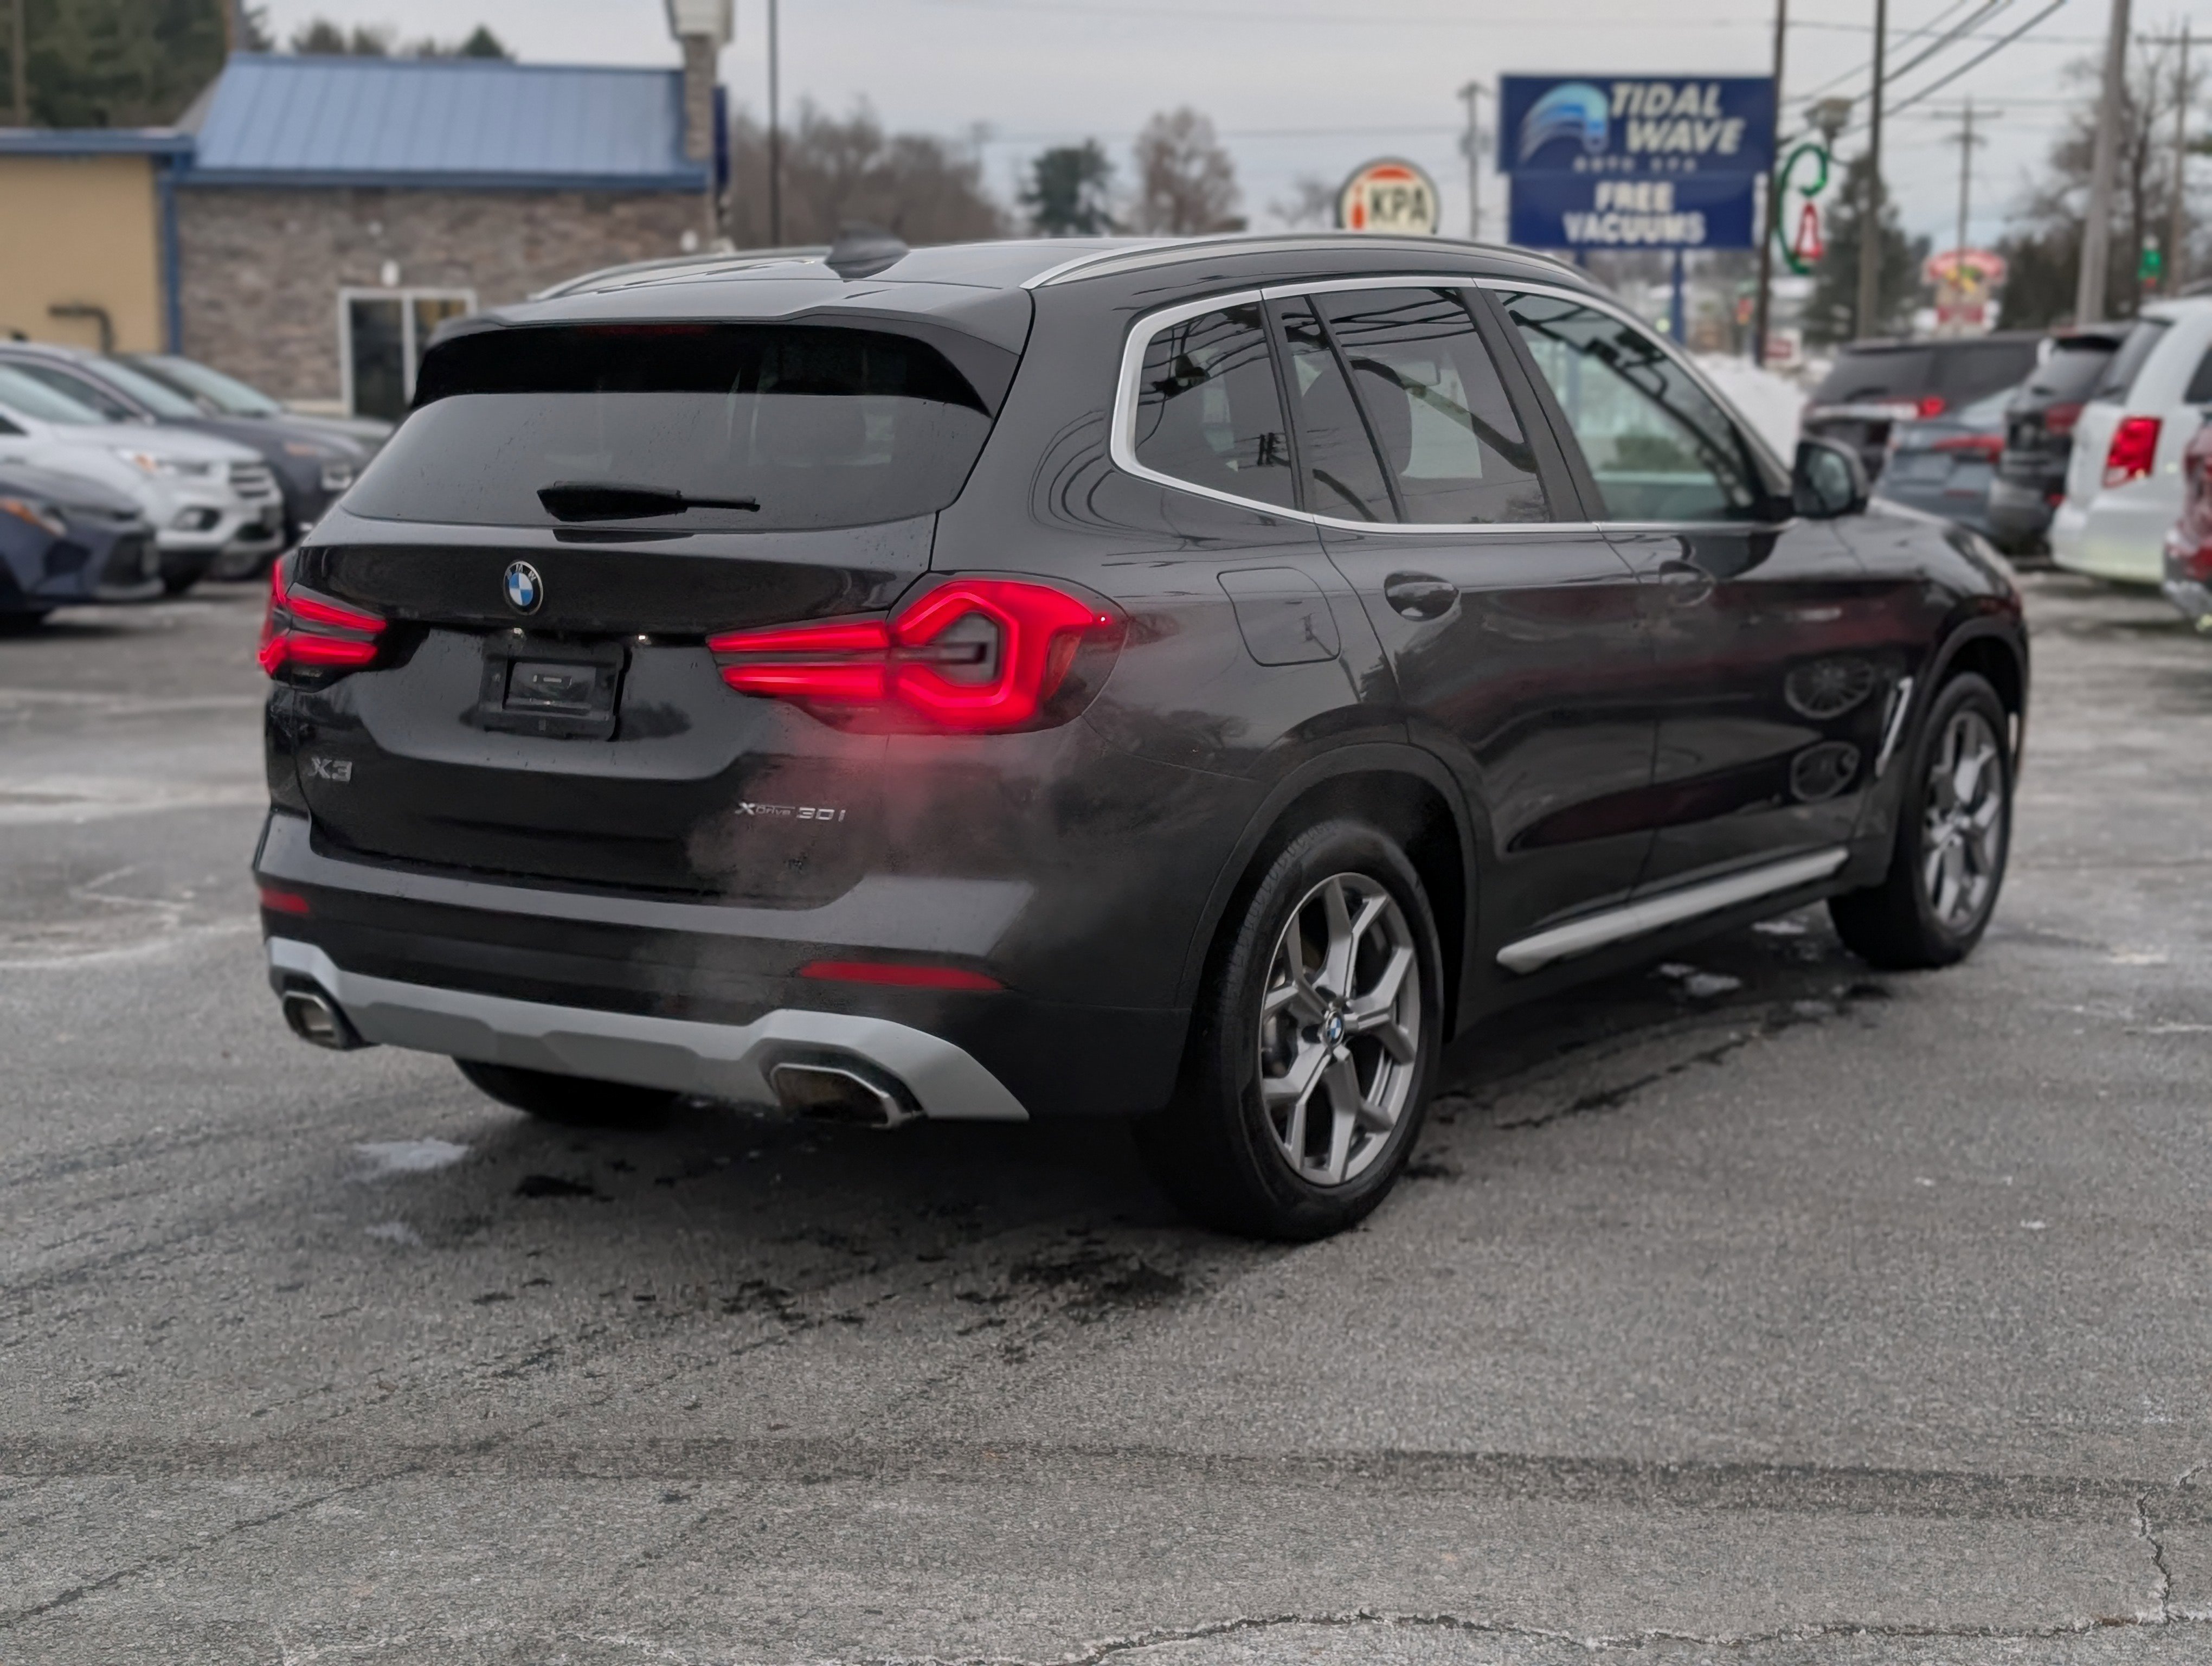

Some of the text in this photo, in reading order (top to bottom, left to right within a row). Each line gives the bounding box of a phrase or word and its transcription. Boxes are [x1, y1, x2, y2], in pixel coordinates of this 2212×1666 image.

[1610, 83, 1722, 117] TIDAL
[1627, 119, 1745, 153] WAVE
[1596, 182, 1674, 212] FREE
[1562, 213, 1706, 243] VACUUMS
[307, 757, 352, 782] X3
